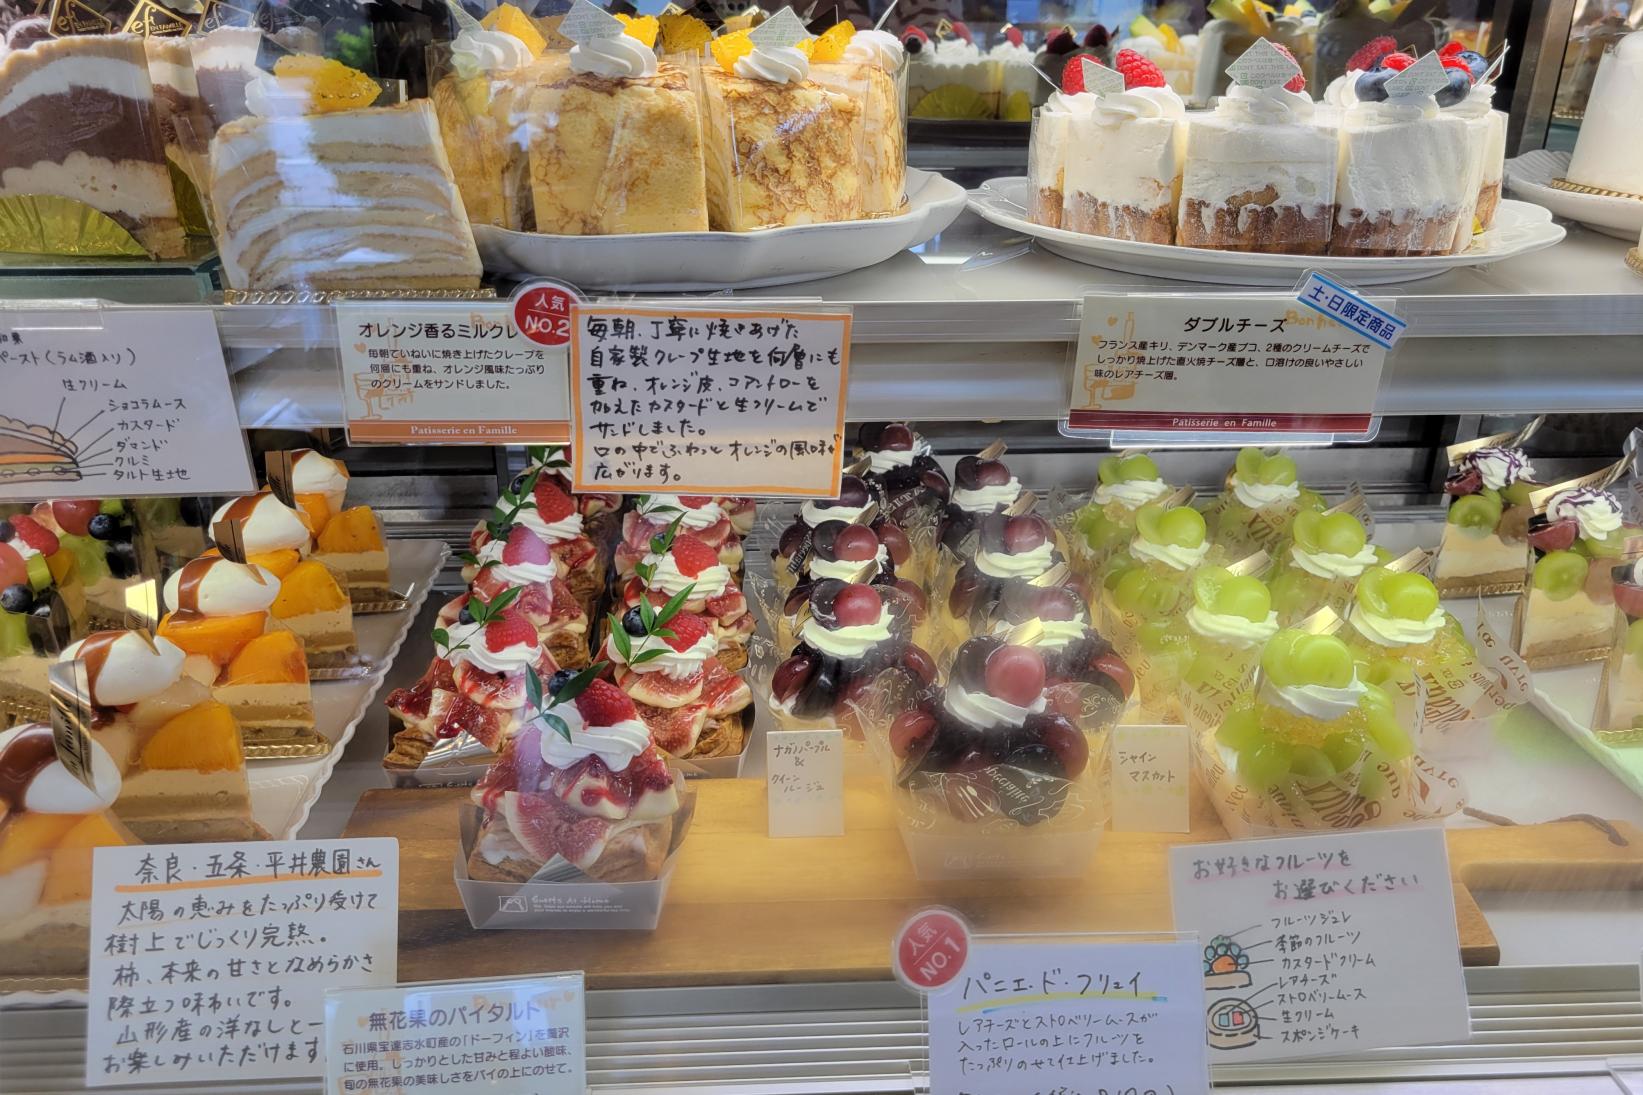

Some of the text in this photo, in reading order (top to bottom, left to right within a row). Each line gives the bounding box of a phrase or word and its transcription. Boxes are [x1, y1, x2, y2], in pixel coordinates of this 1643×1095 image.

[534, 293, 565, 312] 人気
[1308, 284, 1396, 341] 土・日限定商品
[525, 315, 569, 337] NO.2
[587, 315, 799, 342] 毎朝、丁寧に焼きあげた
[1184, 316, 1287, 334] ダブルチーズ
[368, 348, 545, 361] 毎朝ていねいに焼き上げたクレープを
[589, 343, 841, 370] 自家製クレープ生地を何層にも
[62, 378, 127, 391] 生クリーム
[371, 378, 512, 391] のクリームをサンドしました。
[586, 370, 820, 396] 重ね、オレンジ皮、コアントローを
[1094, 369, 1178, 381] 味のレアチーズ層。
[108, 398, 187, 412] ショコラムース
[590, 395, 828, 416] 加えたカスタードと生クリームで
[117, 417, 181, 432] カスタード
[410, 425, 461, 435] Patisserie
[478, 425, 518, 435] Famille
[589, 418, 706, 438] サンドしました。
[1172, 418, 1218, 428] Patisserie
[1241, 418, 1277, 428] Famille
[593, 433, 842, 461] 口の中でふわっとオレンジの風味が
[115, 456, 150, 467] クルミ
[594, 460, 681, 484] 広がります。
[113, 468, 191, 481] タルト生地
[1118, 751, 1157, 766] シャイン
[1129, 769, 1176, 783] マスカット
[134, 848, 381, 885] 奈良・五条・平井農園さん
[1193, 850, 1352, 880] お好きなフルーツを
[1273, 872, 1418, 900] お選びください
[118, 891, 378, 926] 太陽の恵みをたっぷり受けて
[1271, 910, 1352, 929] フルーツジュレ
[104, 922, 327, 956] 樹上でじっくり完熟。
[907, 921, 938, 956] 人気
[1275, 931, 1361, 953] 季節のフルーツ
[919, 935, 962, 982] NO.1
[1281, 953, 1376, 971] カスタードクリーム
[112, 954, 374, 988] 柿、本来の甘さとなめらかさ
[1279, 973, 1337, 989] レアチーズ
[107, 986, 292, 1022] 際立つ味わいです。
[1277, 988, 1367, 1006] ストロベリームース
[368, 1001, 541, 1032] 無花果のパイタルト
[958, 1012, 1158, 1036] レアチーズとストロベリームースが
[1282, 1010, 1334, 1023] 生クリーム
[958, 1032, 1145, 1053] 入ったロールの上にフルーツを
[1280, 1024, 1360, 1044] スポンジケーキ
[102, 1036, 328, 1074] お楽しみいただけます
[960, 1049, 1155, 1075] たっぷりのせて仕上げました。
